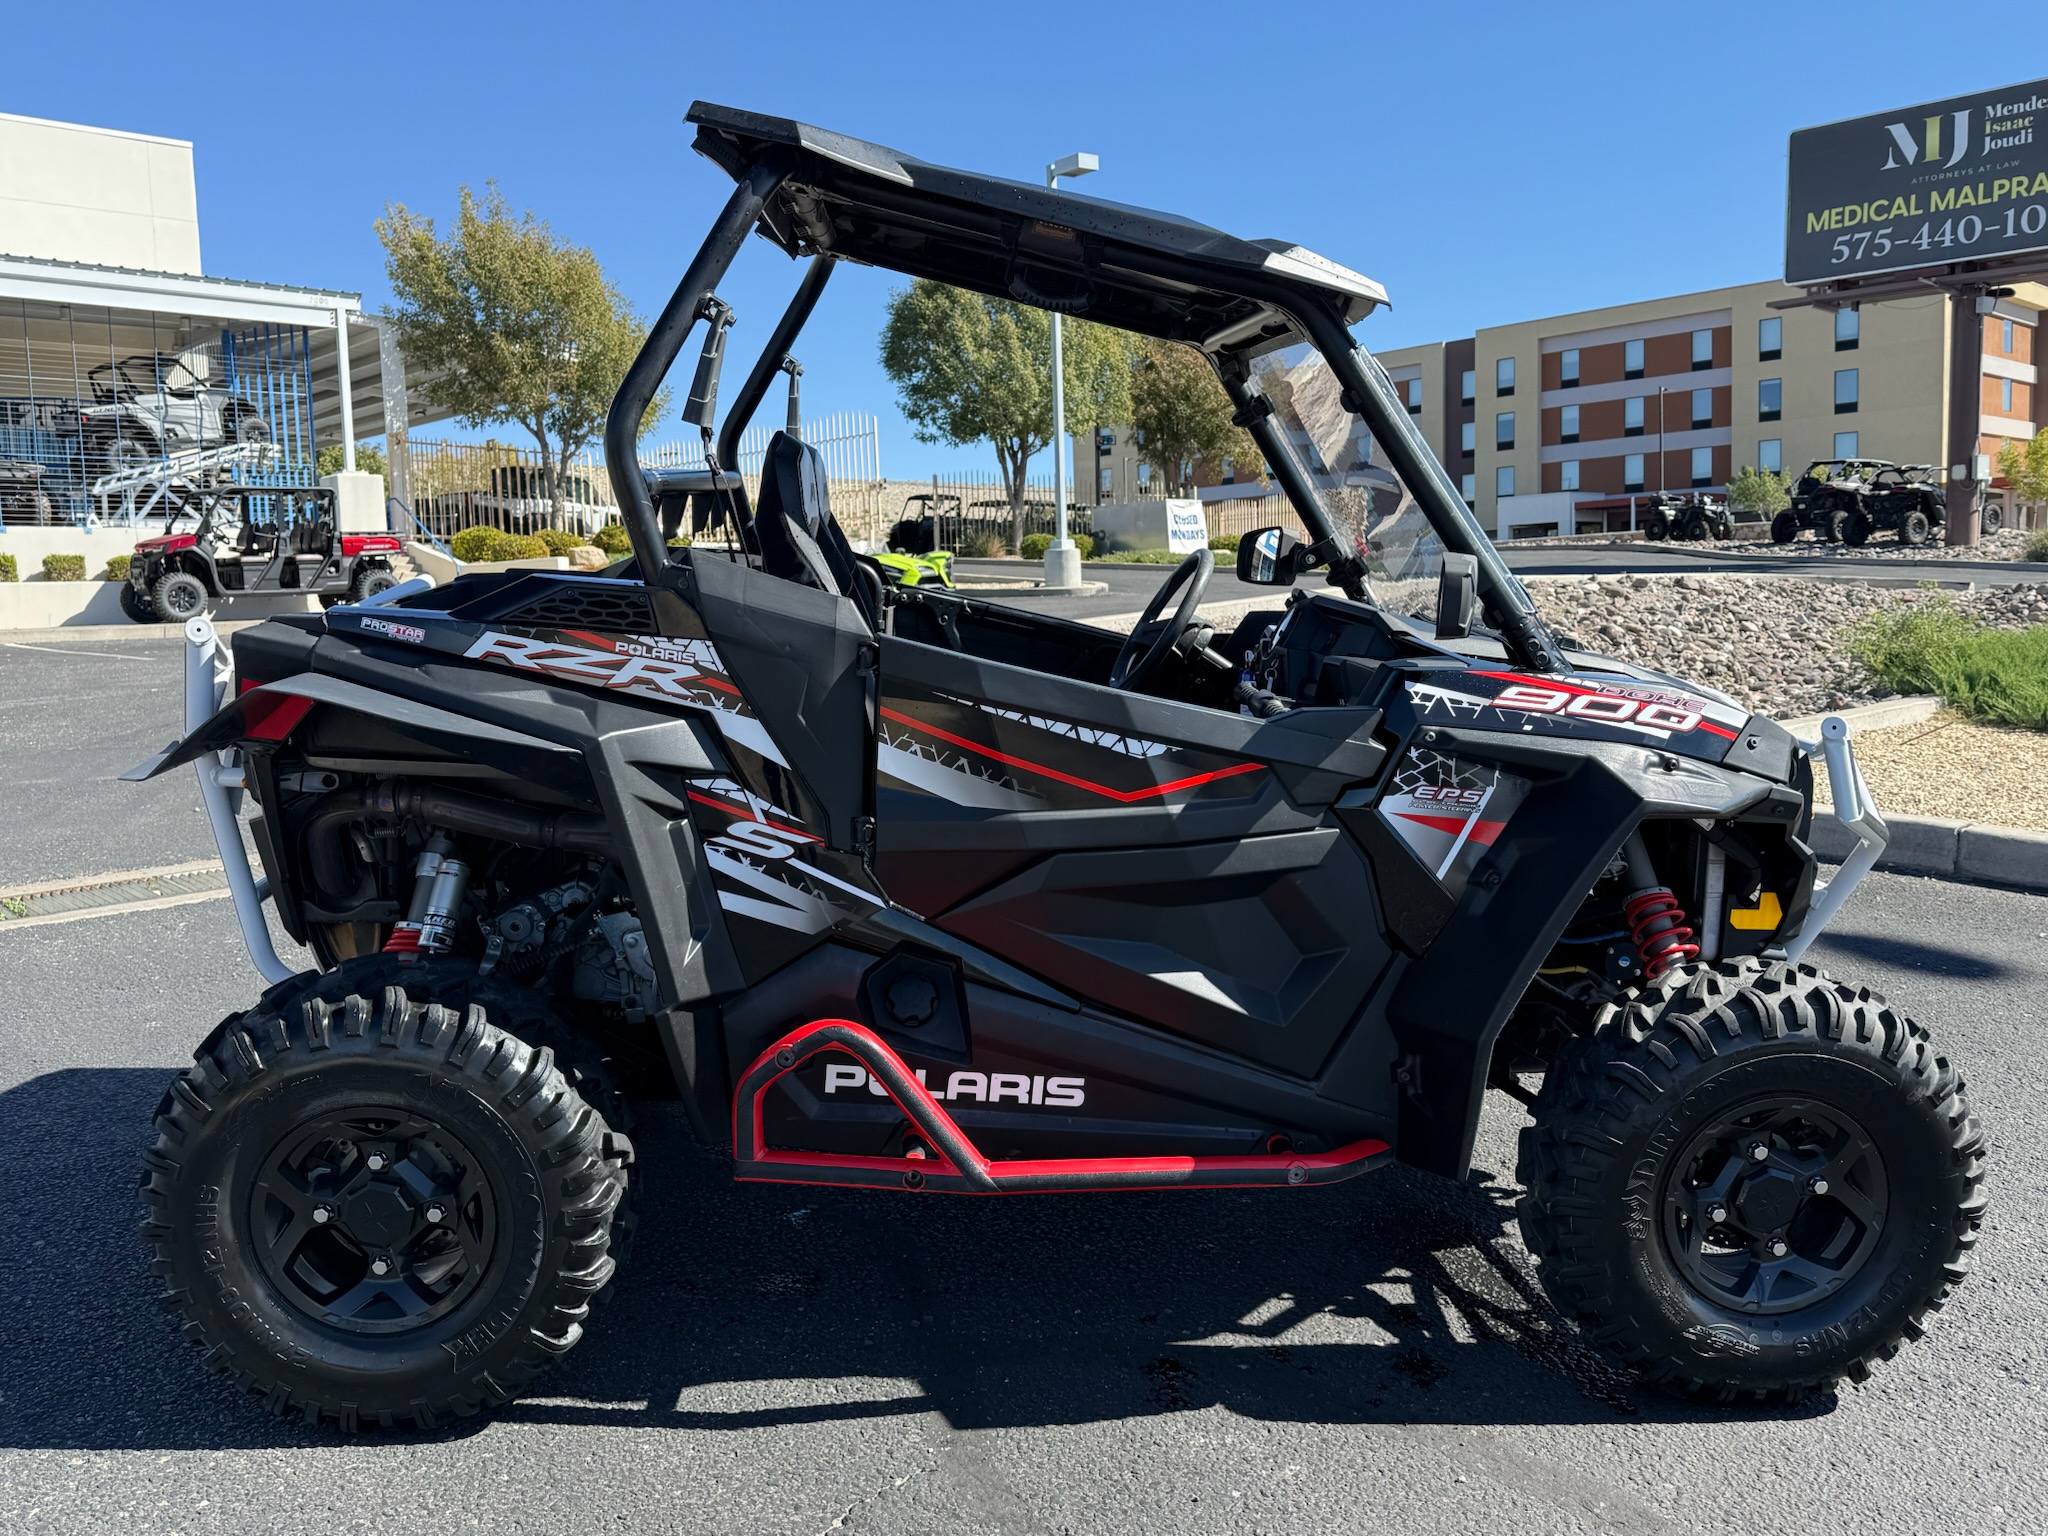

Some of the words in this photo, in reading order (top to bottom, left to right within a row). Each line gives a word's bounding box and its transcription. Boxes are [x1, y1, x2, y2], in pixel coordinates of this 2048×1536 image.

[1984, 115, 2034, 135] Isaac
[1981, 128, 2033, 157] Joudi
[1911, 167, 1974, 185] ATTORNEYS
[1978, 164, 1992, 174] AT
[1996, 159, 2020, 170] LAW
[1806, 193, 1923, 234] MEDICAL
[1831, 203, 2047, 264] 575-440-10
[361, 617, 425, 640] PROSTAR
[463, 631, 703, 697] RZR
[615, 641, 696, 664] POLARIS
[1490, 685, 1703, 732] 900
[1412, 785, 1485, 804] EPS
